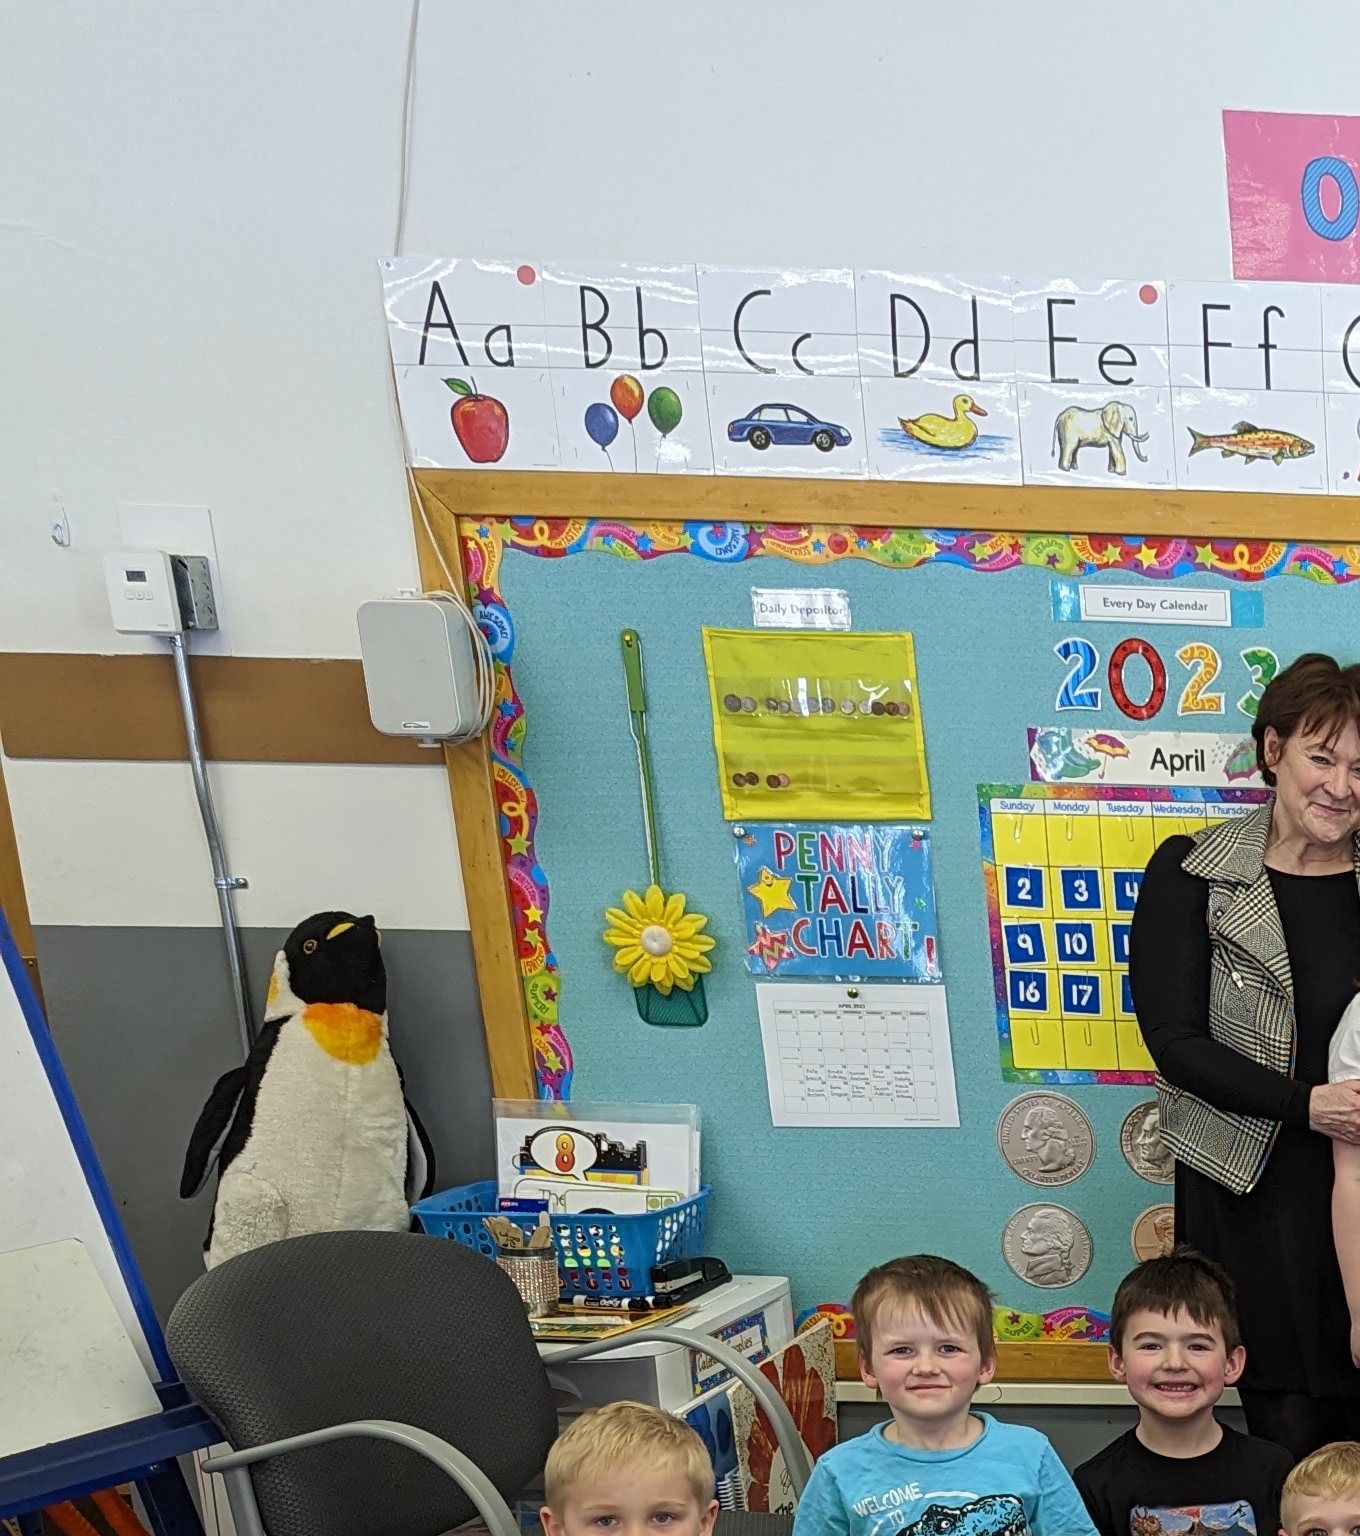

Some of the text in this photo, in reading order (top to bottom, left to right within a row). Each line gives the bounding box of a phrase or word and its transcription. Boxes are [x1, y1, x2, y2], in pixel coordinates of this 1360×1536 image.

[1301, 156, 1360, 240] 0
[419, 282, 513, 367] Aa
[580, 287, 668, 370] Bb
[733, 291, 814, 375] Cc
[890, 295, 980, 382] Dd
[1048, 298, 1138, 387] Ee
[1203, 305, 1284, 390] Ff
[759, 603, 845, 617] Daily Depositor
[1103, 597, 1208, 612] Every Day Calendar
[1150, 748, 1206, 777] April
[1000, 801, 1204, 815] Sunday Monday Tuesday Wednesday
[775, 831, 893, 875] PENNY
[797, 875, 903, 915] TALLY
[1017, 878, 1088, 902] 2 3
[792, 919, 936, 977] CHART!
[1018, 933, 1087, 955] 9 10
[1019, 981, 1093, 1006] 16 17
[556, 1133, 575, 1172] 8
[853, 1482, 921, 1518] WELCOME
[888, 1510, 905, 1527] TO
